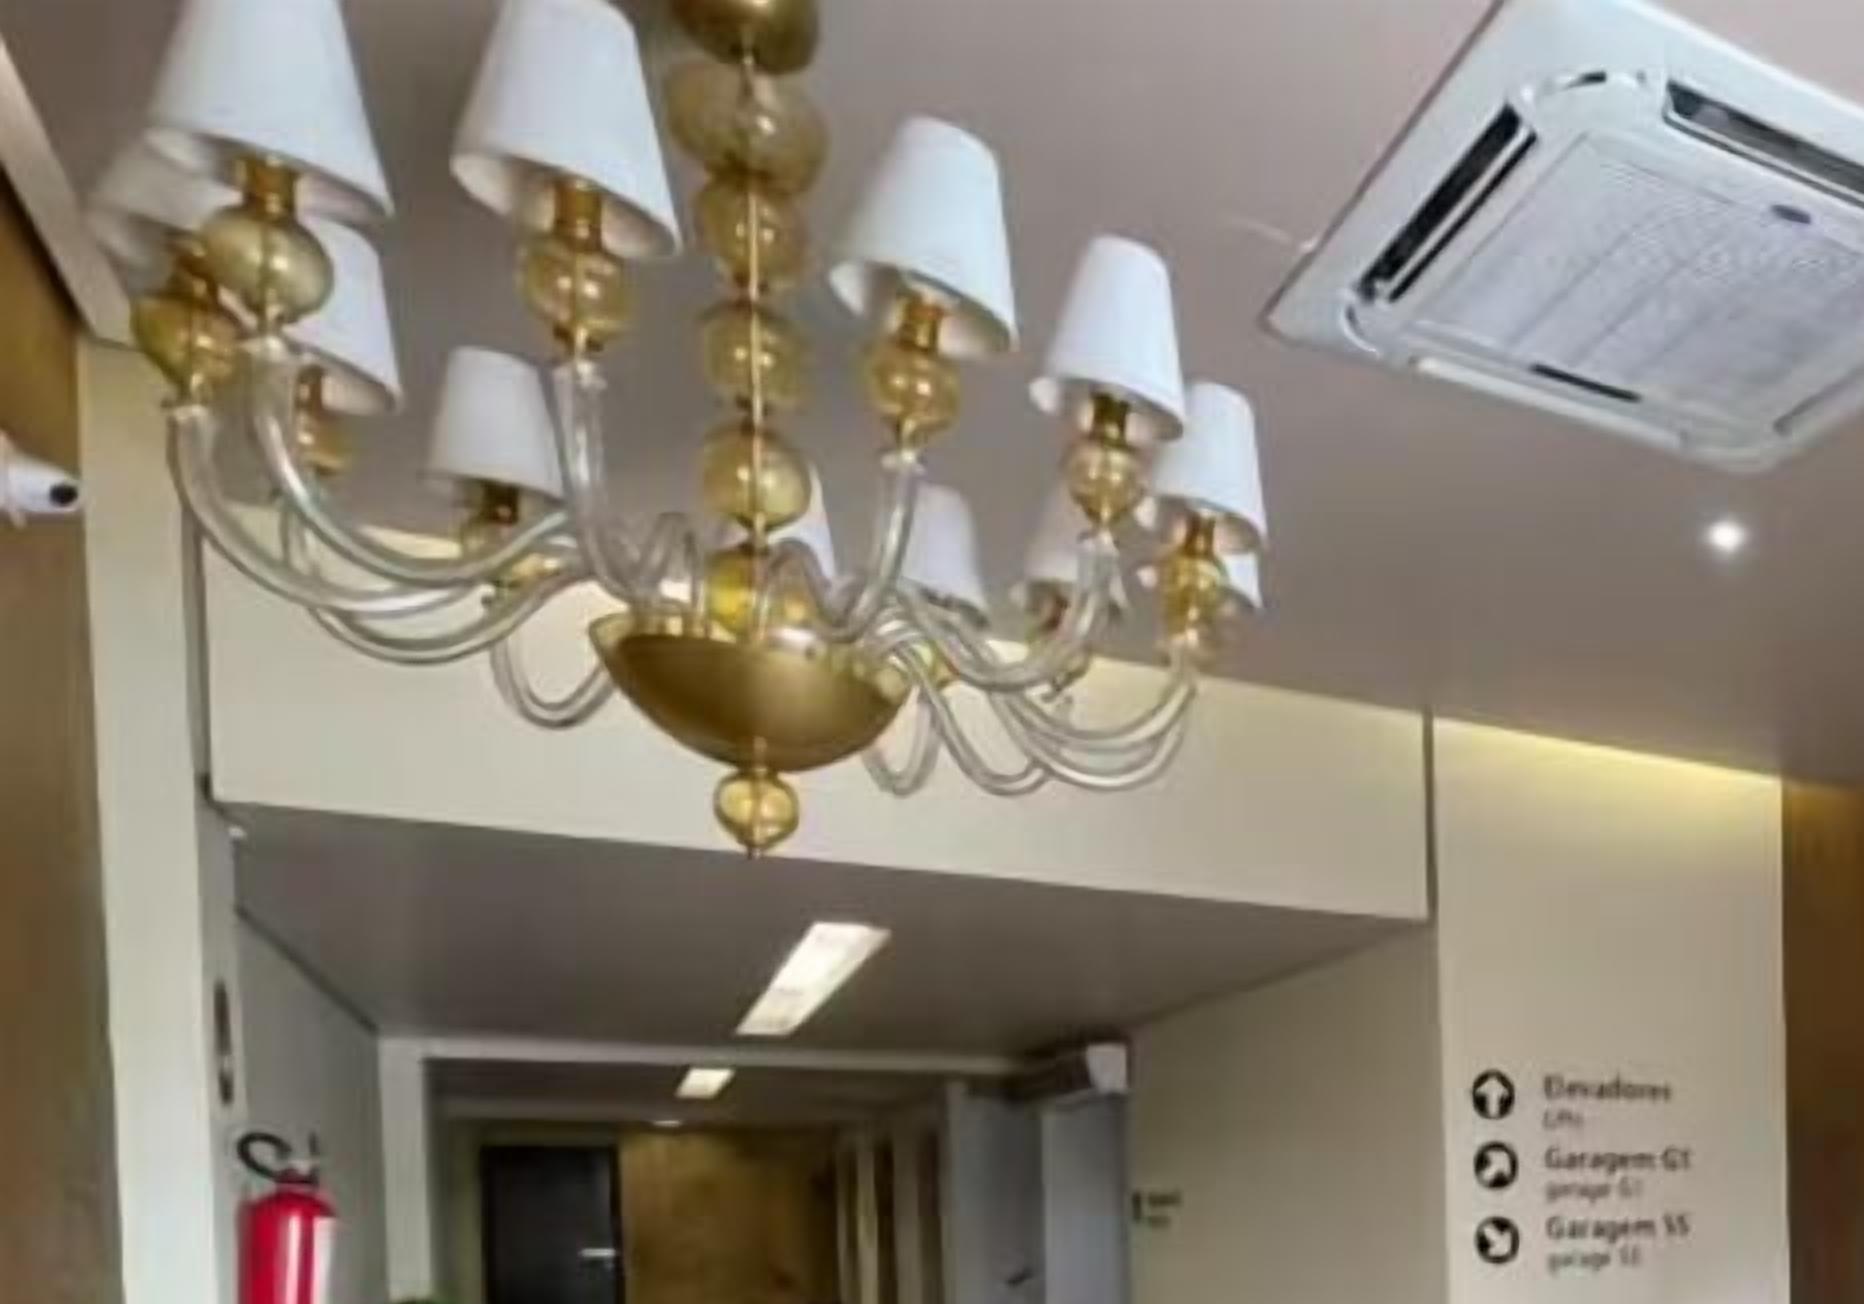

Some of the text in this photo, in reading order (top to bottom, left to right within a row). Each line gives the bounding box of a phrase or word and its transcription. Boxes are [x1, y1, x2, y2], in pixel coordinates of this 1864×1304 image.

[1544, 1070, 1671, 1101] Elevadores
[1545, 1145, 1655, 1175] Garagem
[1546, 1216, 1656, 1244] Garagem
